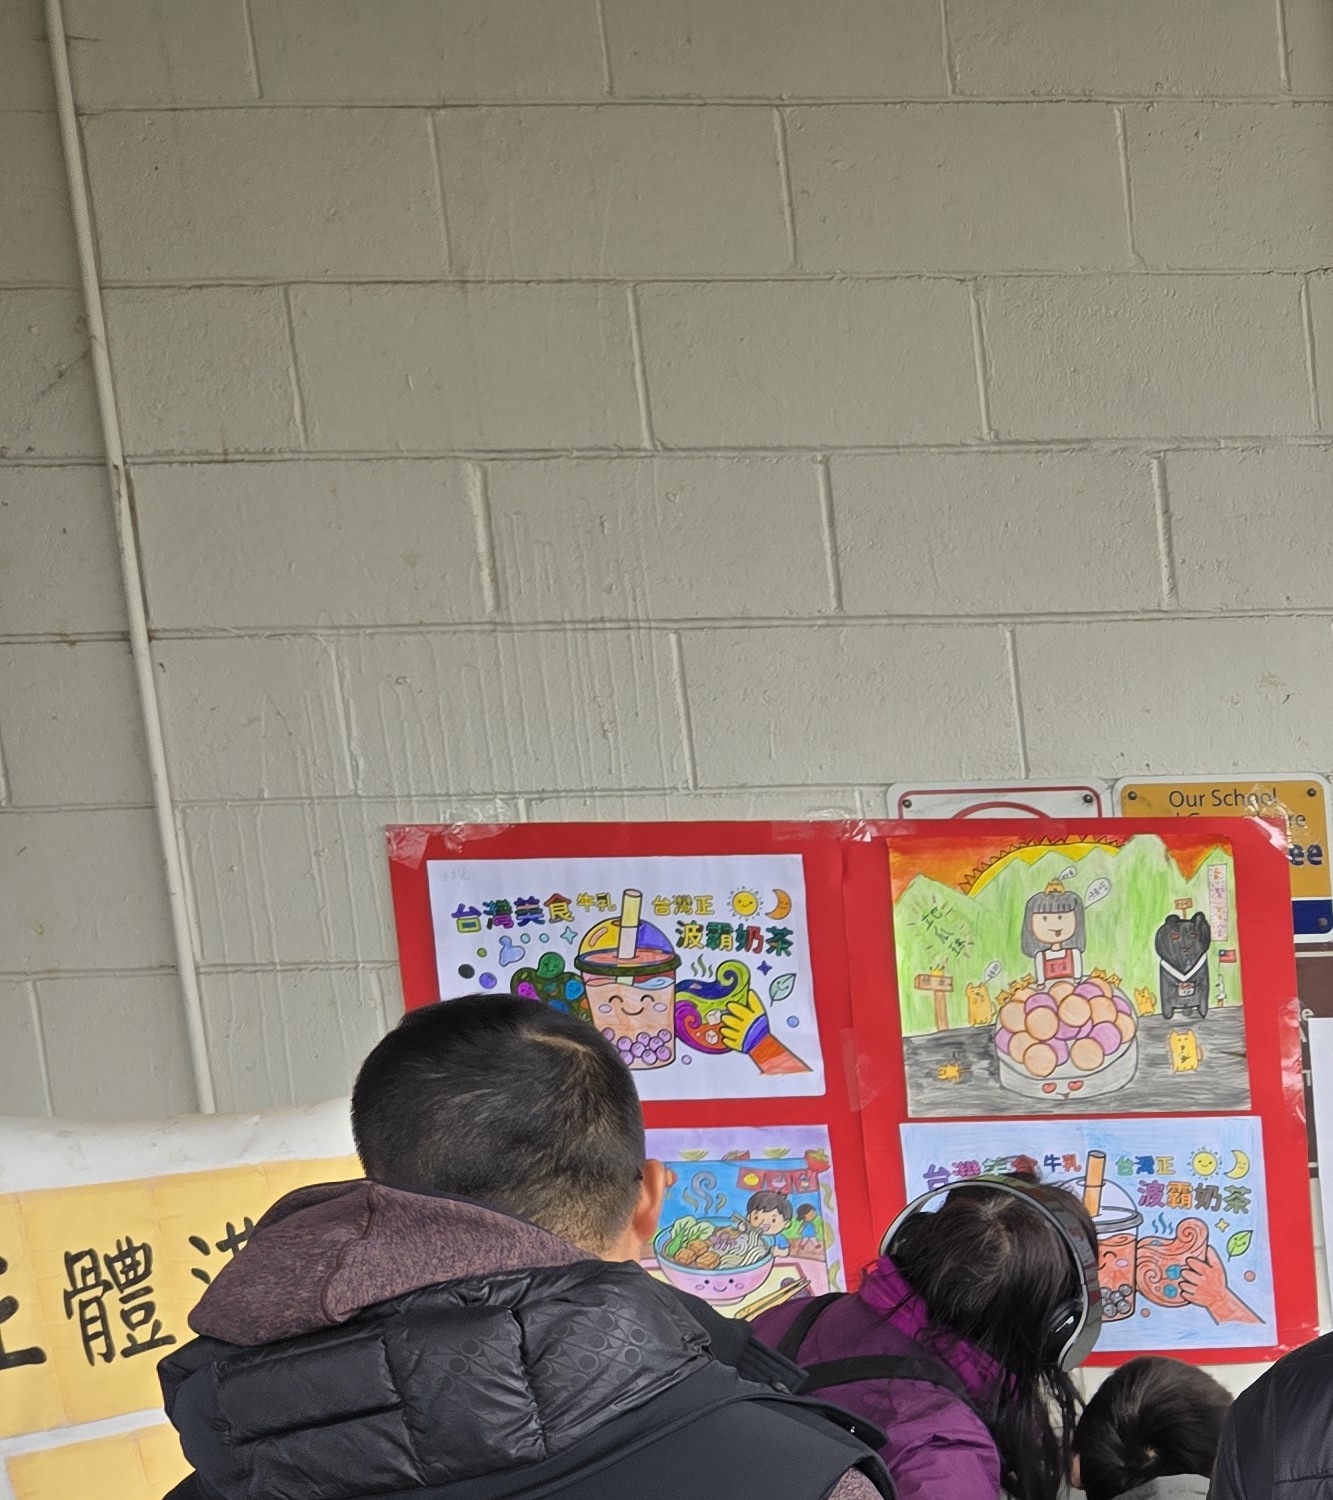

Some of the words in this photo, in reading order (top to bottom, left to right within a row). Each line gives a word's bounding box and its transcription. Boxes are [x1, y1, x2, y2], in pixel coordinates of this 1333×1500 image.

[1169, 790, 1206, 807] Our
[1211, 787, 1277, 807] School
[452, 892, 575, 934] 台灣美食
[576, 892, 617, 912] 牛乳
[651, 894, 716, 916] 台灣正
[675, 920, 794, 957] 波霸奶茶
[1043, 1154, 1082, 1173] 牛乳
[1115, 1155, 1176, 1177] 台灣正
[1137, 1180, 1252, 1214] 波霸奶茶
